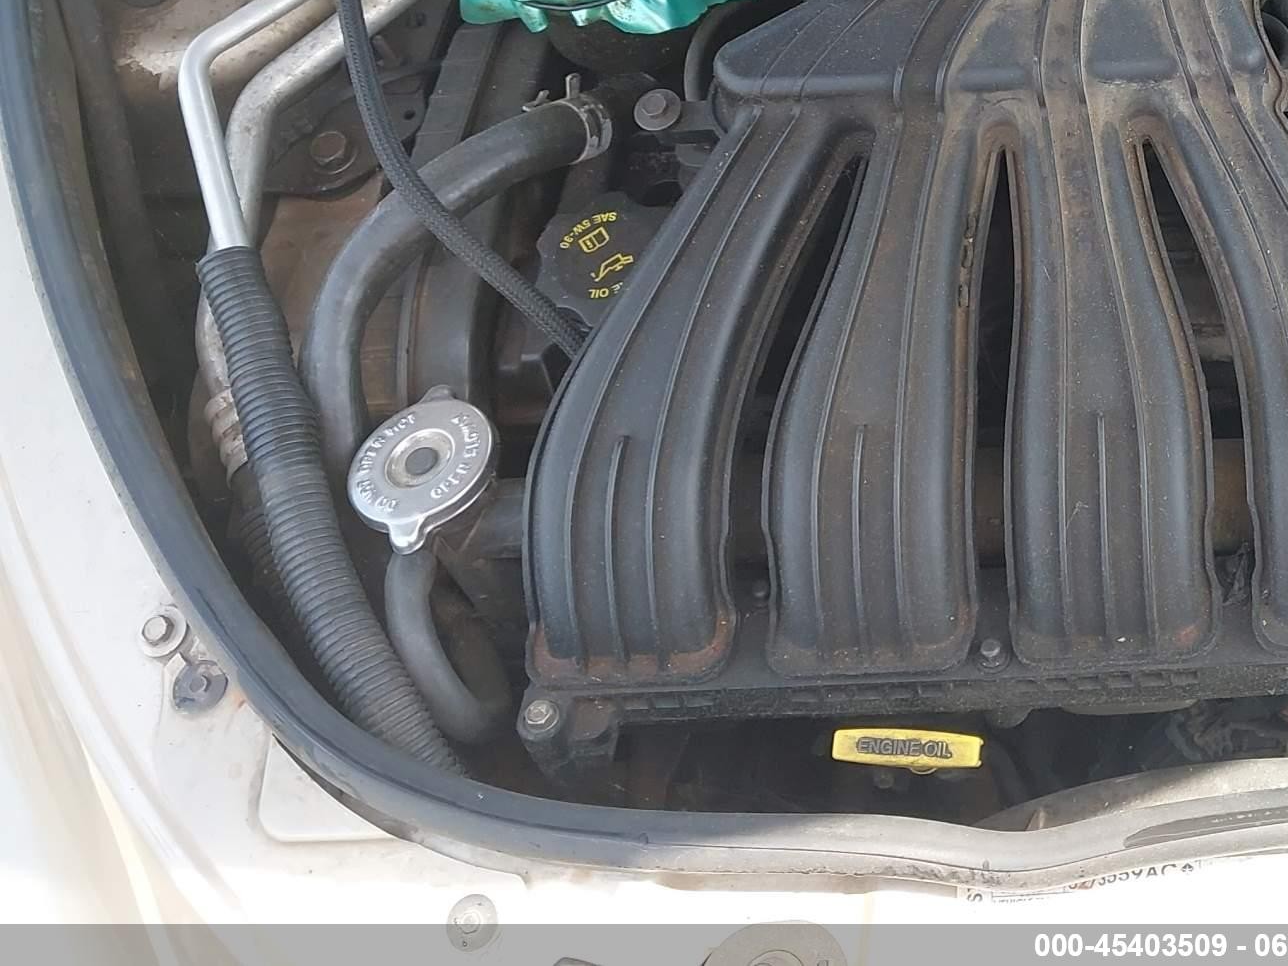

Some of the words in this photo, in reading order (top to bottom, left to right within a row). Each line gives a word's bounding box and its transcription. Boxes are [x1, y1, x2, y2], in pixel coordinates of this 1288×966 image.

[591, 211, 618, 225] SAE
[559, 219, 592, 250] 5W-30
[588, 287, 610, 299] OIL
[856, 737, 921, 756] ENGINE
[923, 740, 952, 758] OIL
